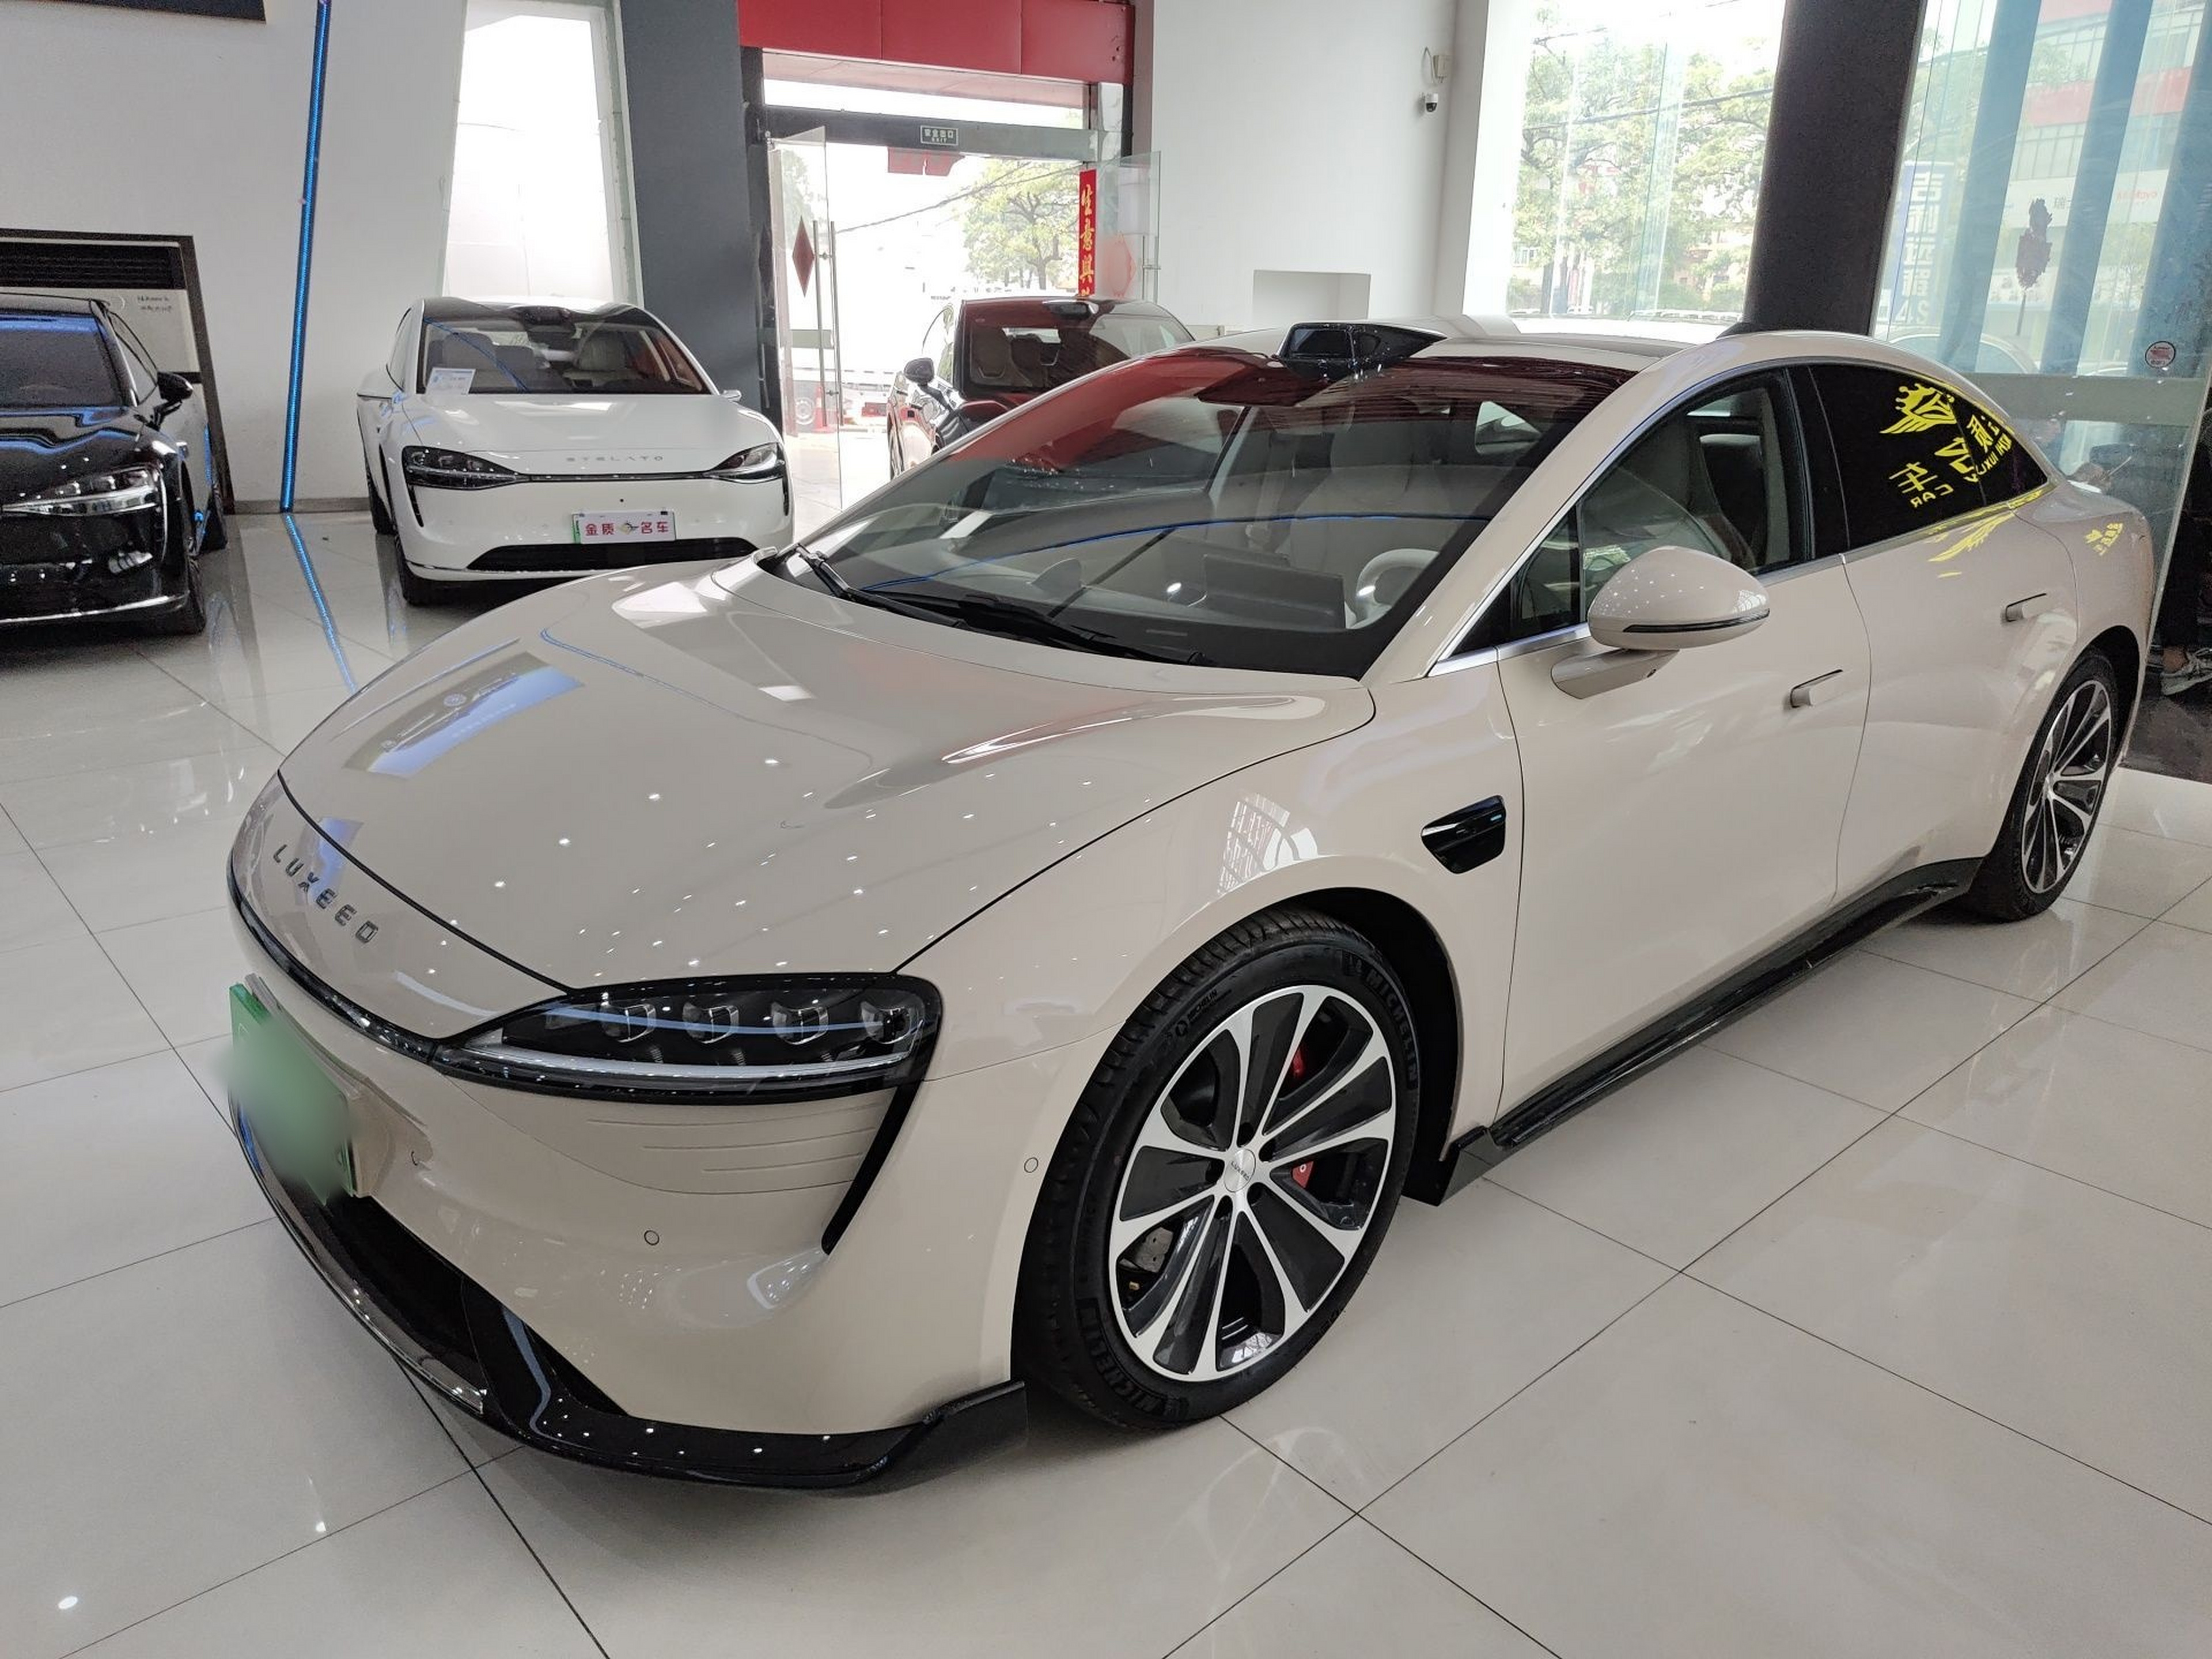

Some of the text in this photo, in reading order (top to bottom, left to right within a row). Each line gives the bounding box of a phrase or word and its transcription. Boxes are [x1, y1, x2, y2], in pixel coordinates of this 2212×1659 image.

[1080, 184, 1094, 296] 生意興
[585, 521, 669, 536] 金质 名车
[272, 843, 378, 944] LUXEED
[1366, 968, 1419, 1082] MICHELIN
